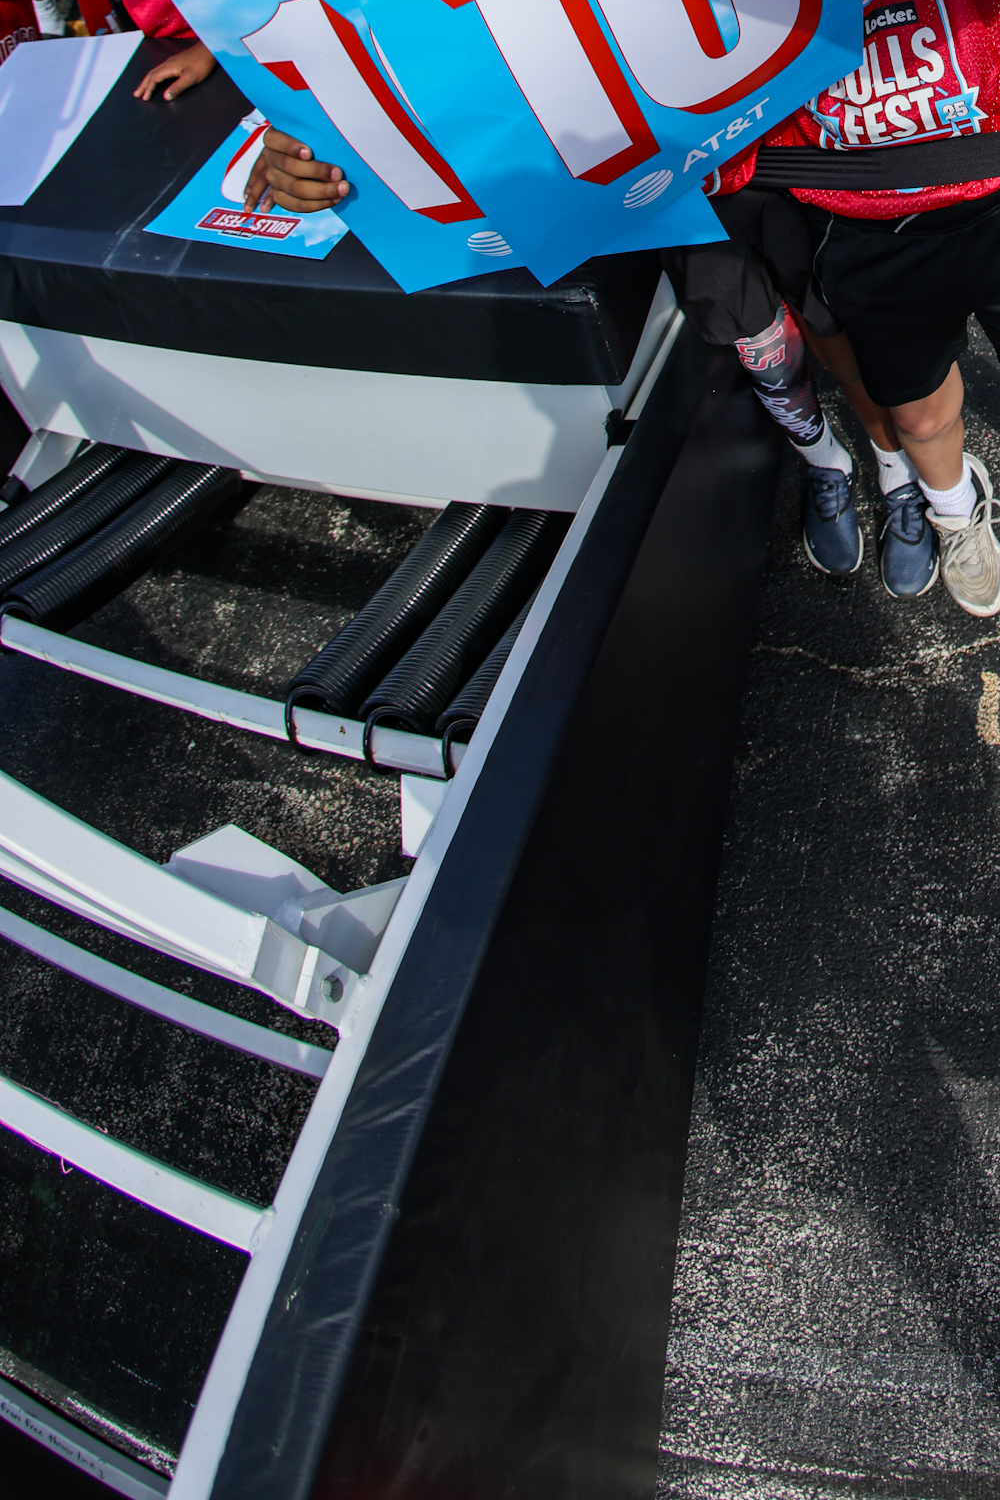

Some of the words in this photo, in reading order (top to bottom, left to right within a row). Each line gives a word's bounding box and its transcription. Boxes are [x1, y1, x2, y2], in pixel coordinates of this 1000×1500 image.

[844, 86, 937, 145] FEST
[942, 100, 970, 120] 25
[681, 97, 770, 173] AT&T
[213, 213, 247, 229] FEST
[250, 218, 295, 235] BULLS
[25, 1414, 43, 1436] free
[49, 1434, 74, 1455] throw
[77, 1451, 95, 1468] line
